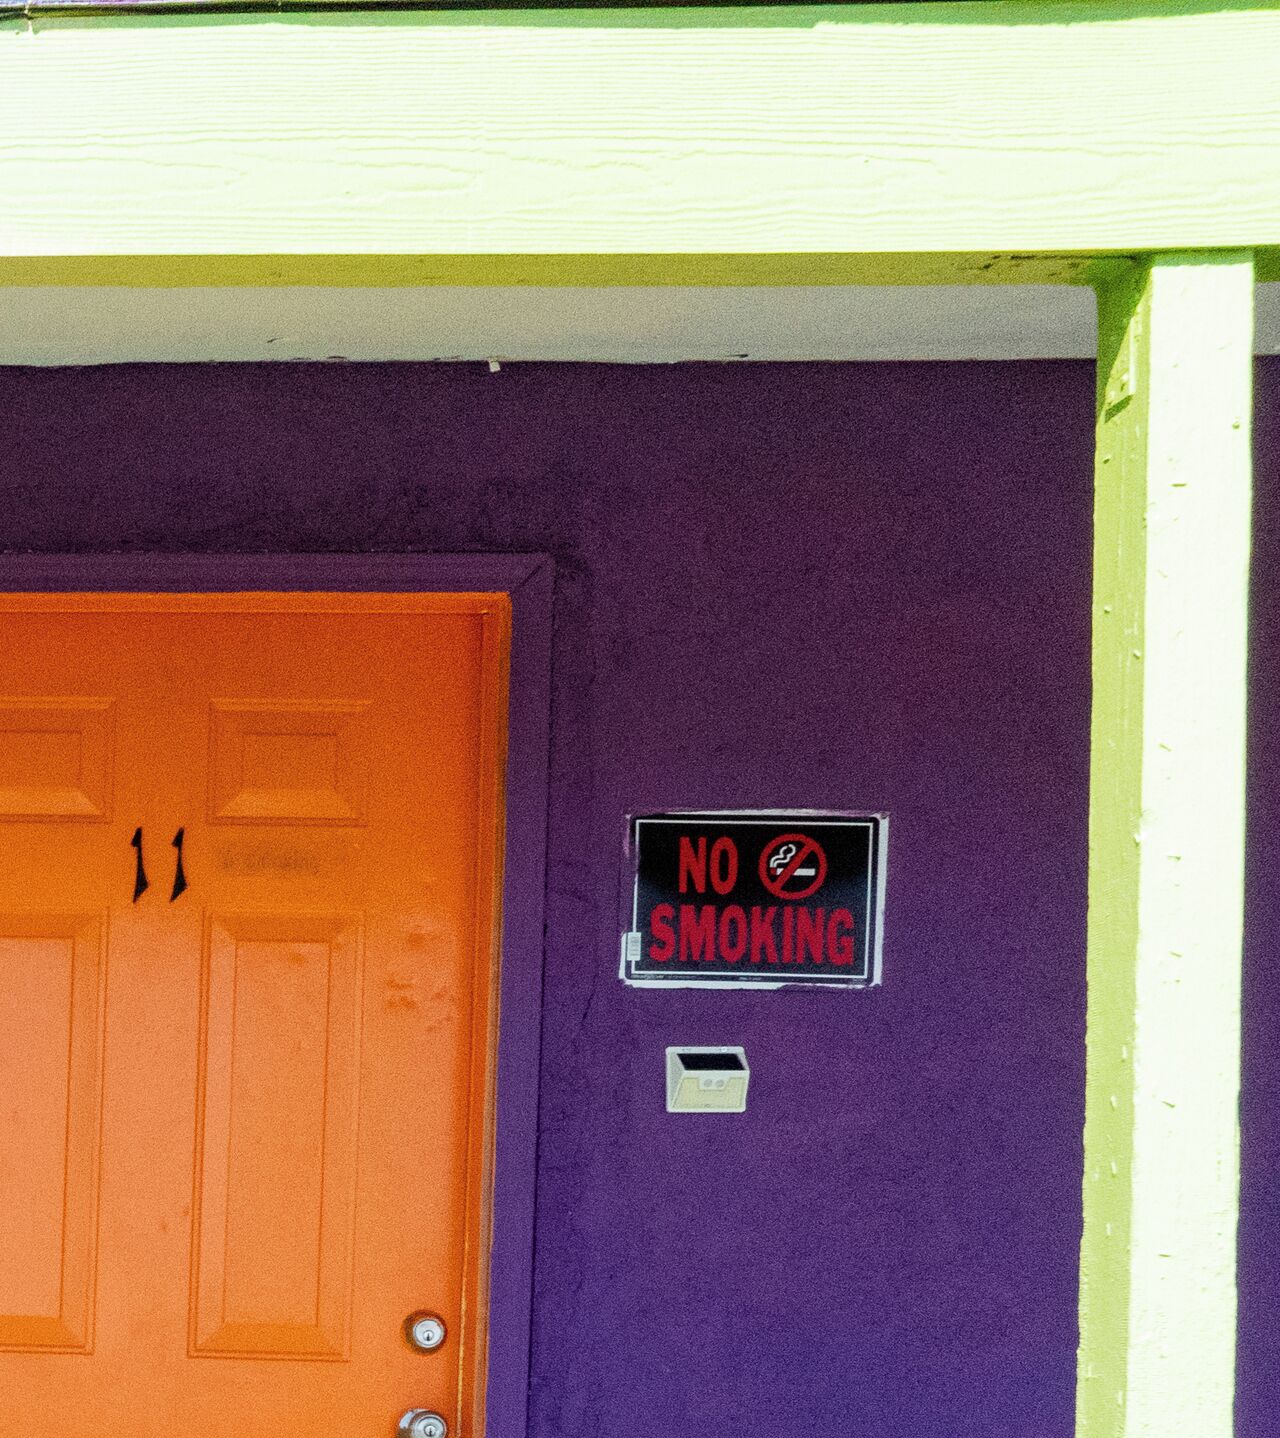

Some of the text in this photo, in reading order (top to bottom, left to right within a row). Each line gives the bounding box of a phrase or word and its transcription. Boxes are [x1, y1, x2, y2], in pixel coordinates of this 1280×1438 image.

[130, 826, 188, 904] 11
[678, 837, 739, 895] NO
[650, 903, 854, 966] SMOKING
